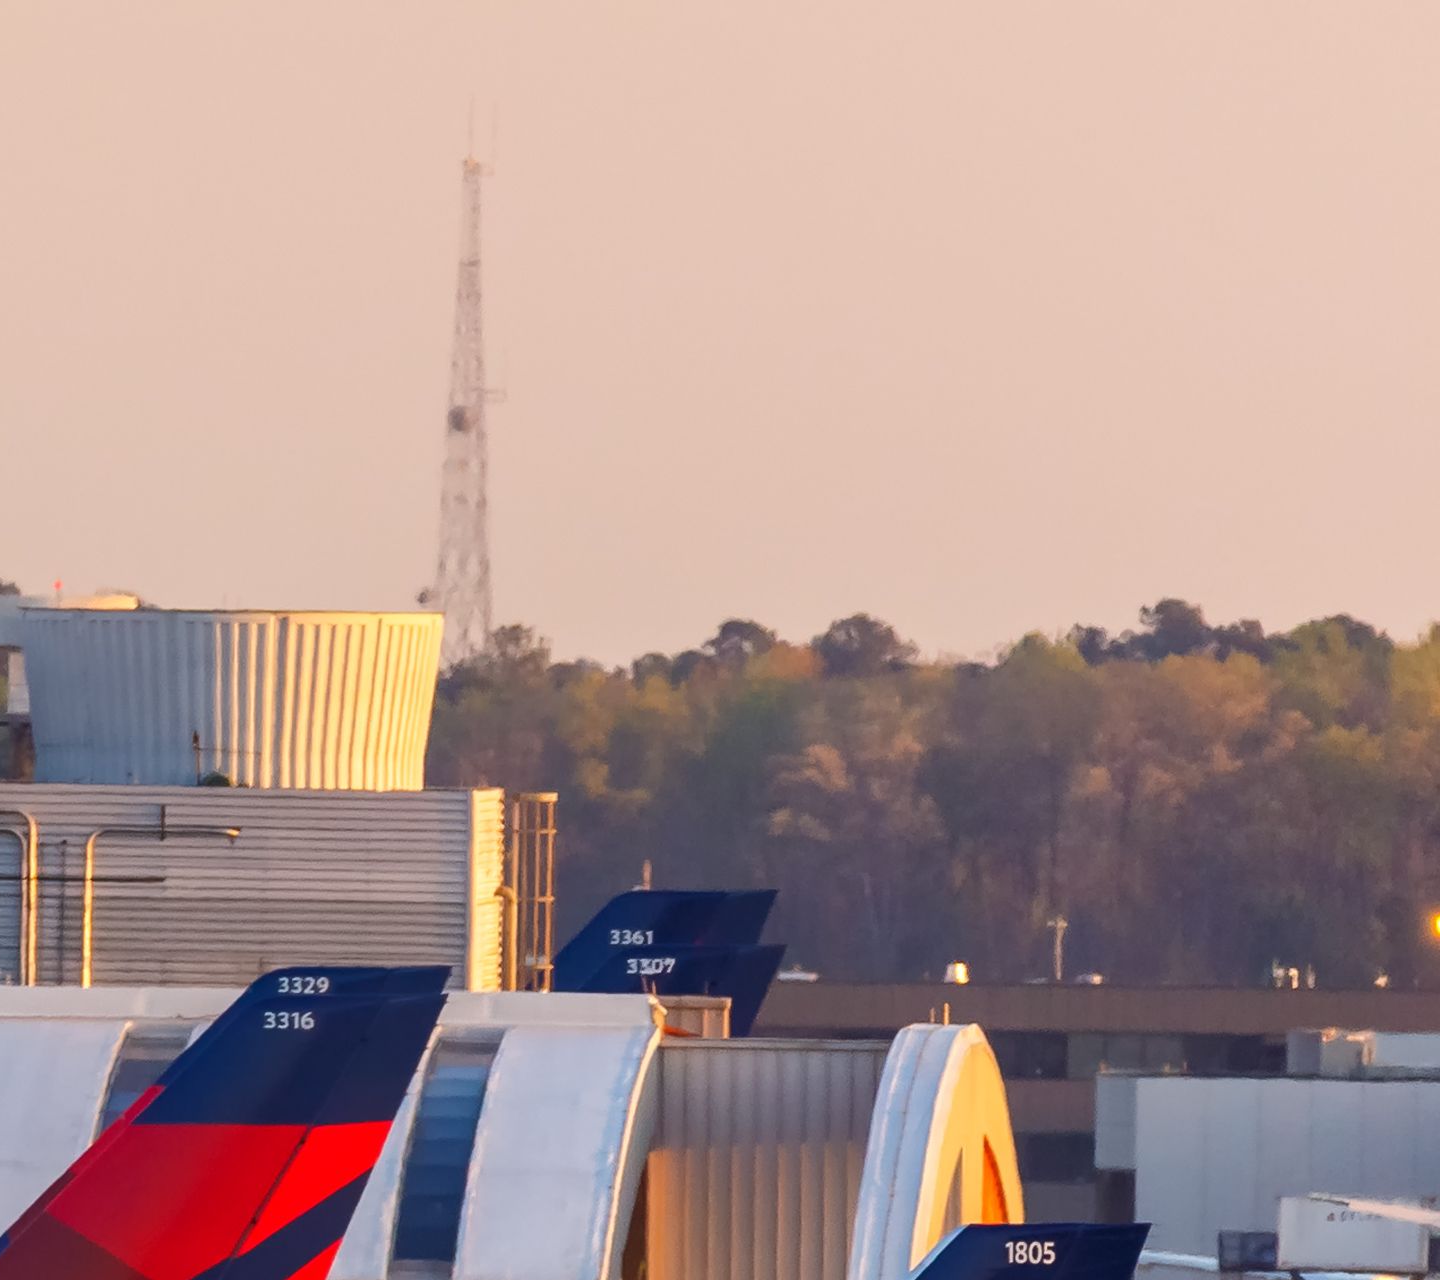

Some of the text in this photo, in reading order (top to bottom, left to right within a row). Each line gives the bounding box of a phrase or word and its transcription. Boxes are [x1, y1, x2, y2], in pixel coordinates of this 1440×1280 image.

[610, 930, 653, 945] 3361
[278, 977, 329, 993] 3329
[263, 1012, 314, 1030] 3316
[1005, 1242, 1056, 1265] 1805
